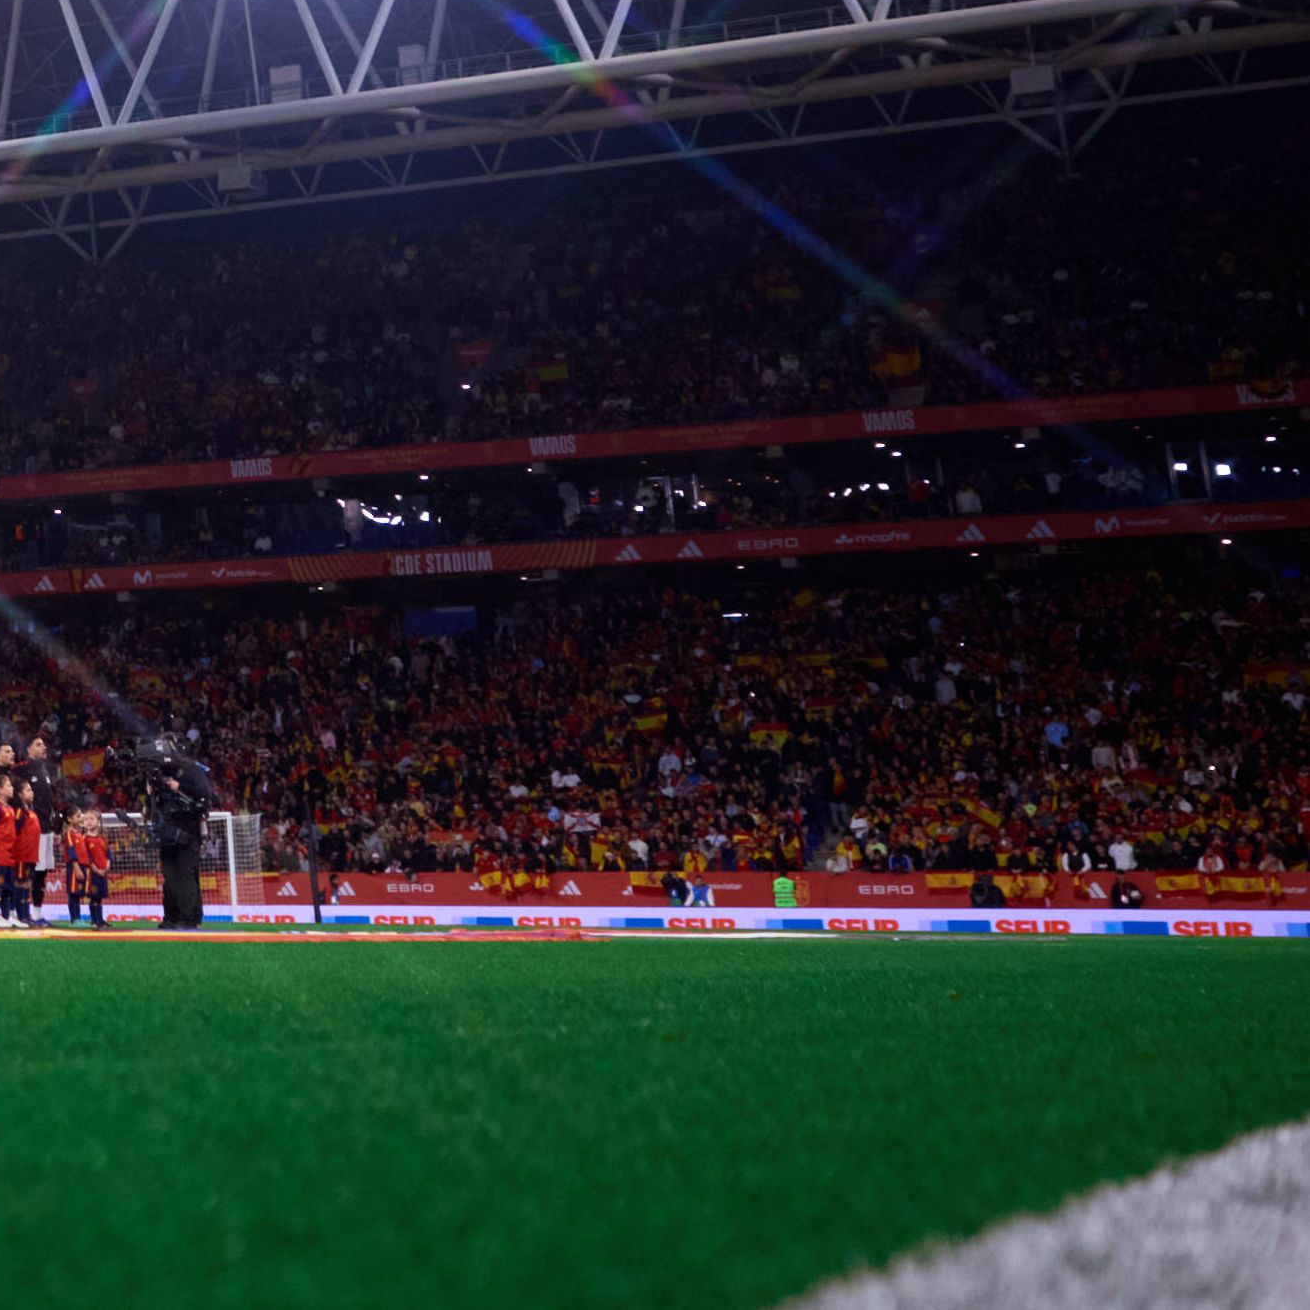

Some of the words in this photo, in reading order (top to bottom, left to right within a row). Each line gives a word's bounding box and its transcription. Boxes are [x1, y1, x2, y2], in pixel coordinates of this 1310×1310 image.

[862, 409, 916, 433] VAMOS
[529, 434, 576, 456] VAMOS
[230, 457, 273, 478] VAMOS
[737, 537, 799, 551] EBRO
[855, 531, 911, 543] mapfre
[393, 553, 422, 576] CDE
[425, 550, 494, 575] STADIUM
[387, 883, 435, 893] EBRO
[858, 884, 914, 895] EBRO
